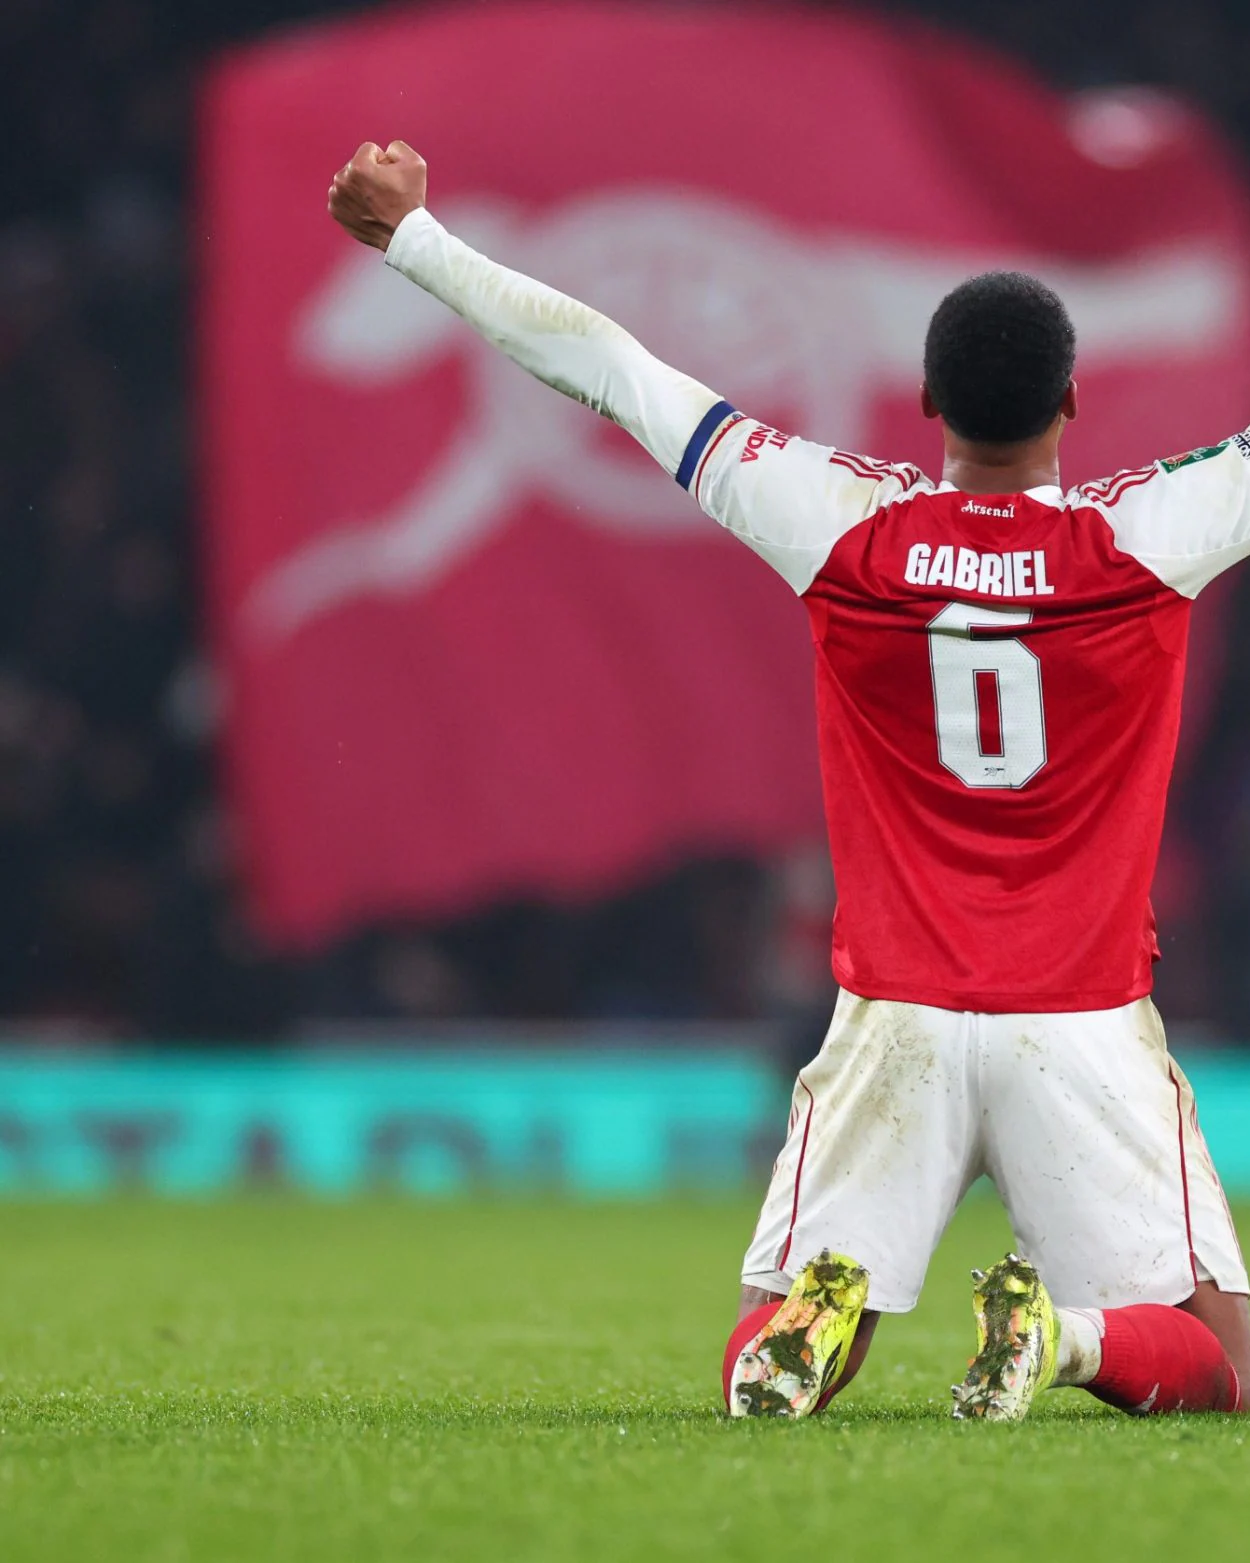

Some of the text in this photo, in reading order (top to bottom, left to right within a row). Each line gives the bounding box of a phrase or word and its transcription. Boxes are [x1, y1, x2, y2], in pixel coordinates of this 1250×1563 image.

[961, 499, 1016, 518] Arsenal
[904, 543, 1055, 597] GABRIEL
[925, 600, 1048, 789] 6
